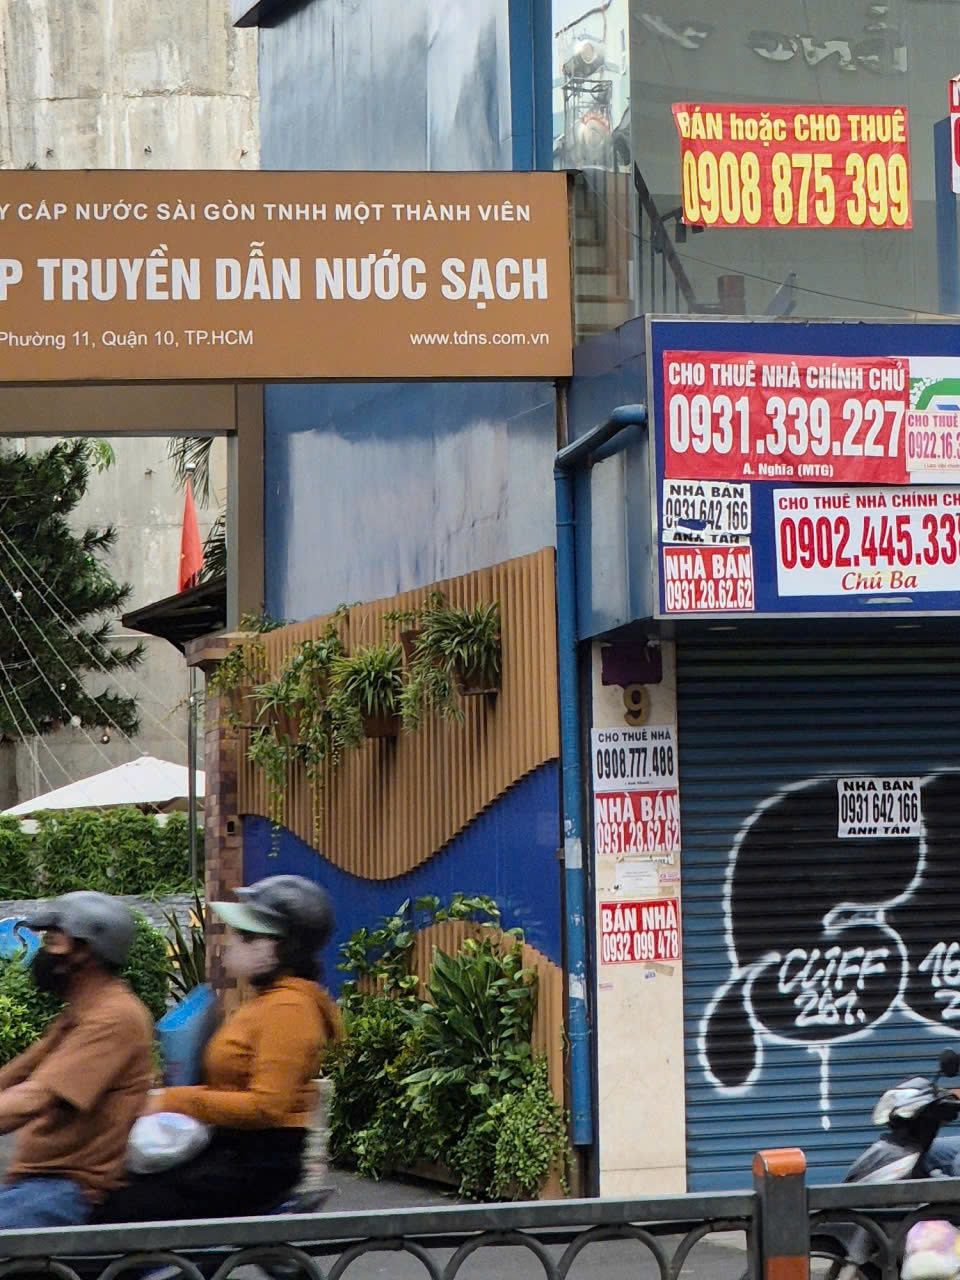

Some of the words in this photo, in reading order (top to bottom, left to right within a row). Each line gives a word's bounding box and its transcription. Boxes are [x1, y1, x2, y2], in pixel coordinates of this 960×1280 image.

[676, 106, 722, 140] BÁN
[730, 112, 787, 147] hoặc
[794, 113, 841, 141] CHO
[847, 109, 906, 142] THUÊ
[683, 150, 762, 224] 0908
[771, 151, 836, 225] 875
[845, 152, 909, 226] 399
[17, 200, 68, 220] CẤP
[75, 200, 148, 220] NƯỚC
[156, 200, 195, 220] SÀI
[204, 200, 255, 220] GÒN
[263, 204, 327, 221] TNHH
[335, 201, 384, 224] MỘT
[392, 200, 470, 221] THÀNH
[478, 200, 530, 221] VIÊN
[37, 243, 200, 301] TRUYỀN
[215, 241, 300, 300] DẪN
[315, 248, 427, 300] NƯỚC
[440, 257, 548, 309] SẠCH
[0, 330, 65, 349] Phường
[72, 331, 96, 348] 11,
[101, 330, 148, 349] Quận
[154, 331, 179, 347] 10,
[184, 330, 254, 345] TP.HCM
[410, 330, 549, 345] www.tdns.com.vn
[668, 362, 705, 386] CHO
[710, 360, 756, 387] THUÊ
[761, 361, 801, 389] NHÀ
[806, 362, 863, 390] CHÍNH
[868, 358, 905, 391] CHỦ
[669, 393, 906, 458] 0931.339.227
[908, 414, 929, 427] CHO
[932, 413, 958, 428] THUÊ
[743, 463, 755, 475] A.
[759, 463, 794, 477] Nghĩa
[797, 463, 834, 477] (MTG)
[778, 496, 808, 510] CHO
[813, 493, 850, 509] THUÊ
[856, 491, 887, 509] NHÀ
[891, 490, 938, 508] CHÍNH
[726, 501, 748, 530] 166
[666, 549, 706, 580] NHÀ
[711, 548, 751, 579] BÁN
[667, 579, 753, 609] 0931.28.62.62
[841, 570, 882, 590] Chú
[890, 570, 918, 589] Ba
[623, 683, 650, 727] 9
[598, 732, 619, 742] CHO
[622, 728, 648, 741] THUÊ
[651, 728, 671, 741] NHÀ
[596, 745, 674, 780] 0908.777.488
[597, 793, 635, 823] NHÀ
[640, 791, 679, 821] BÁN
[841, 793, 869, 823] 0931
[873, 793, 894, 823] 642
[897, 793, 918, 823] 166
[597, 821, 680, 855] 0931.28.62.62
[847, 826, 877, 835] ANH
[602, 904, 637, 932] BÁN
[641, 901, 677, 930] NHÀ
[603, 932, 631, 962] 0932
[633, 931, 655, 960] 099
[657, 930, 679, 958] 478
